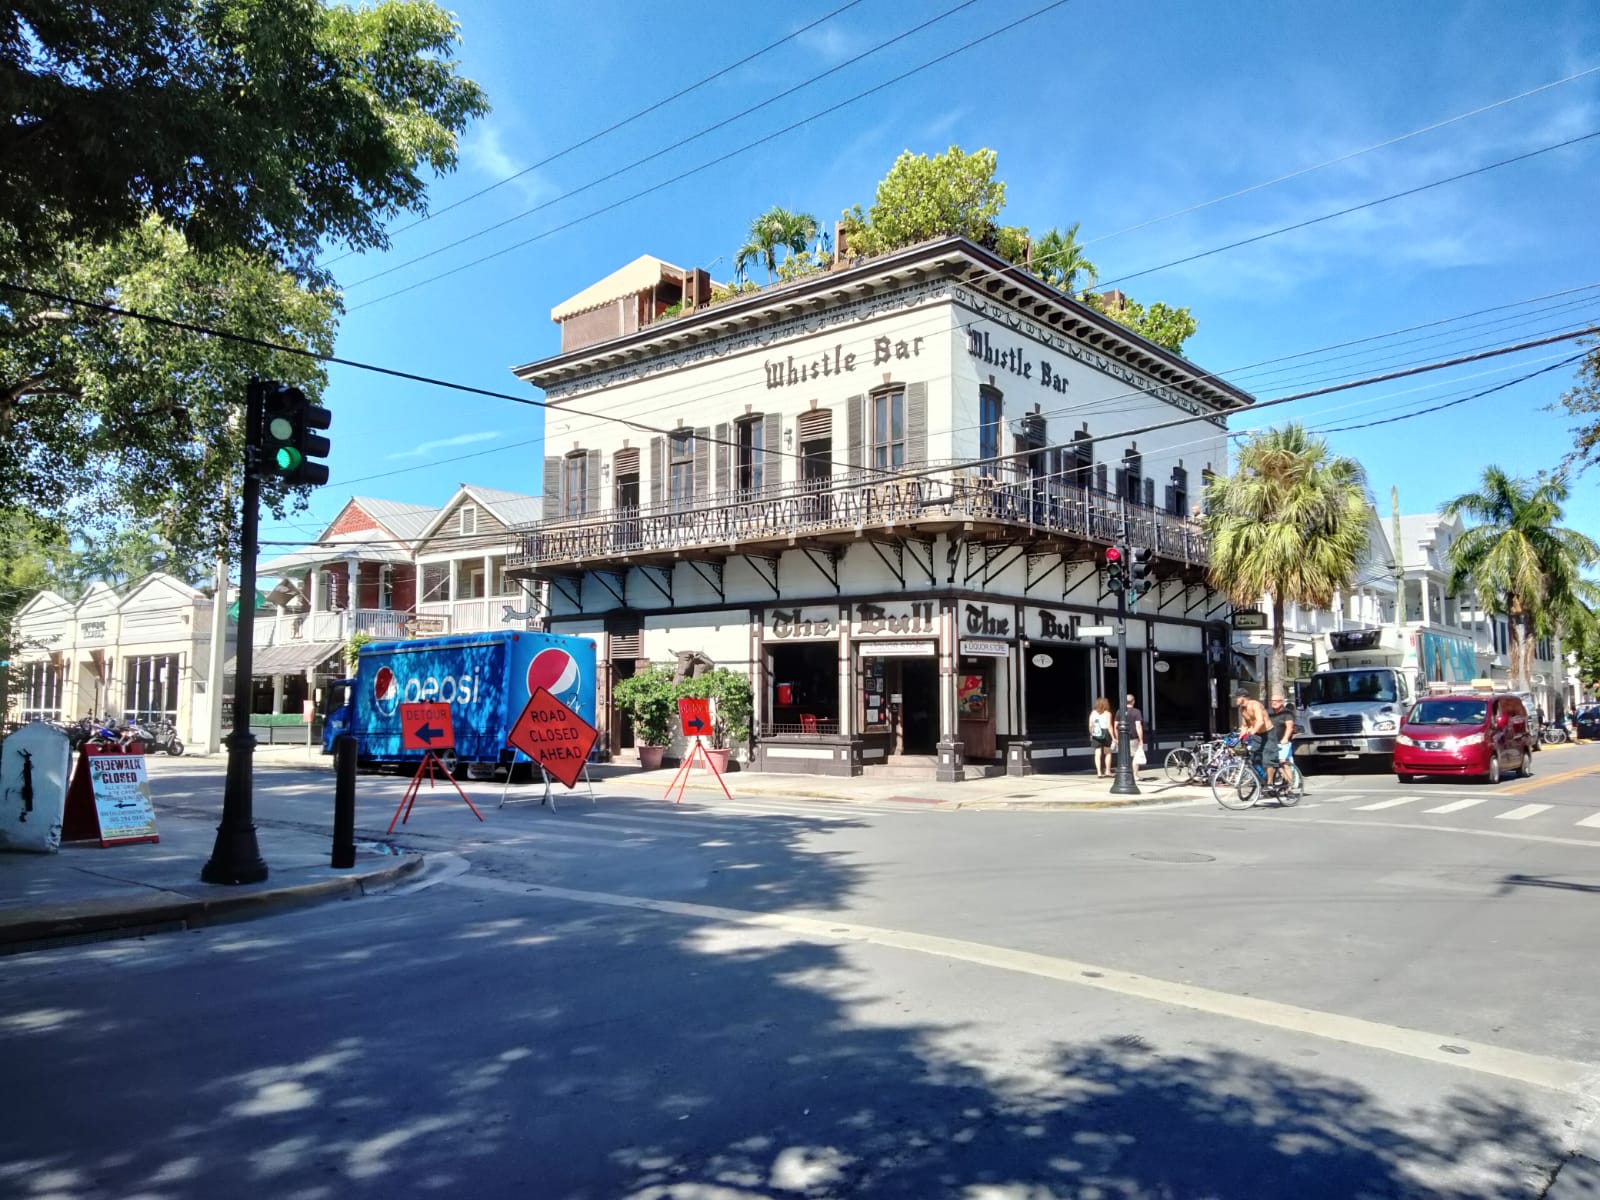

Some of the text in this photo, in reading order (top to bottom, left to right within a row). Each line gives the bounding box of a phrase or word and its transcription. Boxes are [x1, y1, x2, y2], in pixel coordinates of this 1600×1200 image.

[764, 334, 923, 389] Whistle Bar
[967, 323, 1069, 394] Whistle Bar
[772, 602, 934, 638] The Bull
[965, 603, 1081, 641] The Bull
[403, 665, 480, 705] pepsi
[405, 709, 447, 721] DETOUR
[530, 709, 567, 722] ROAD
[529, 727, 579, 742] CLOSED
[540, 745, 582, 760] AHEAD
[95, 759, 141, 770] SIDEWALK
[102, 772, 137, 783] CLOSED
